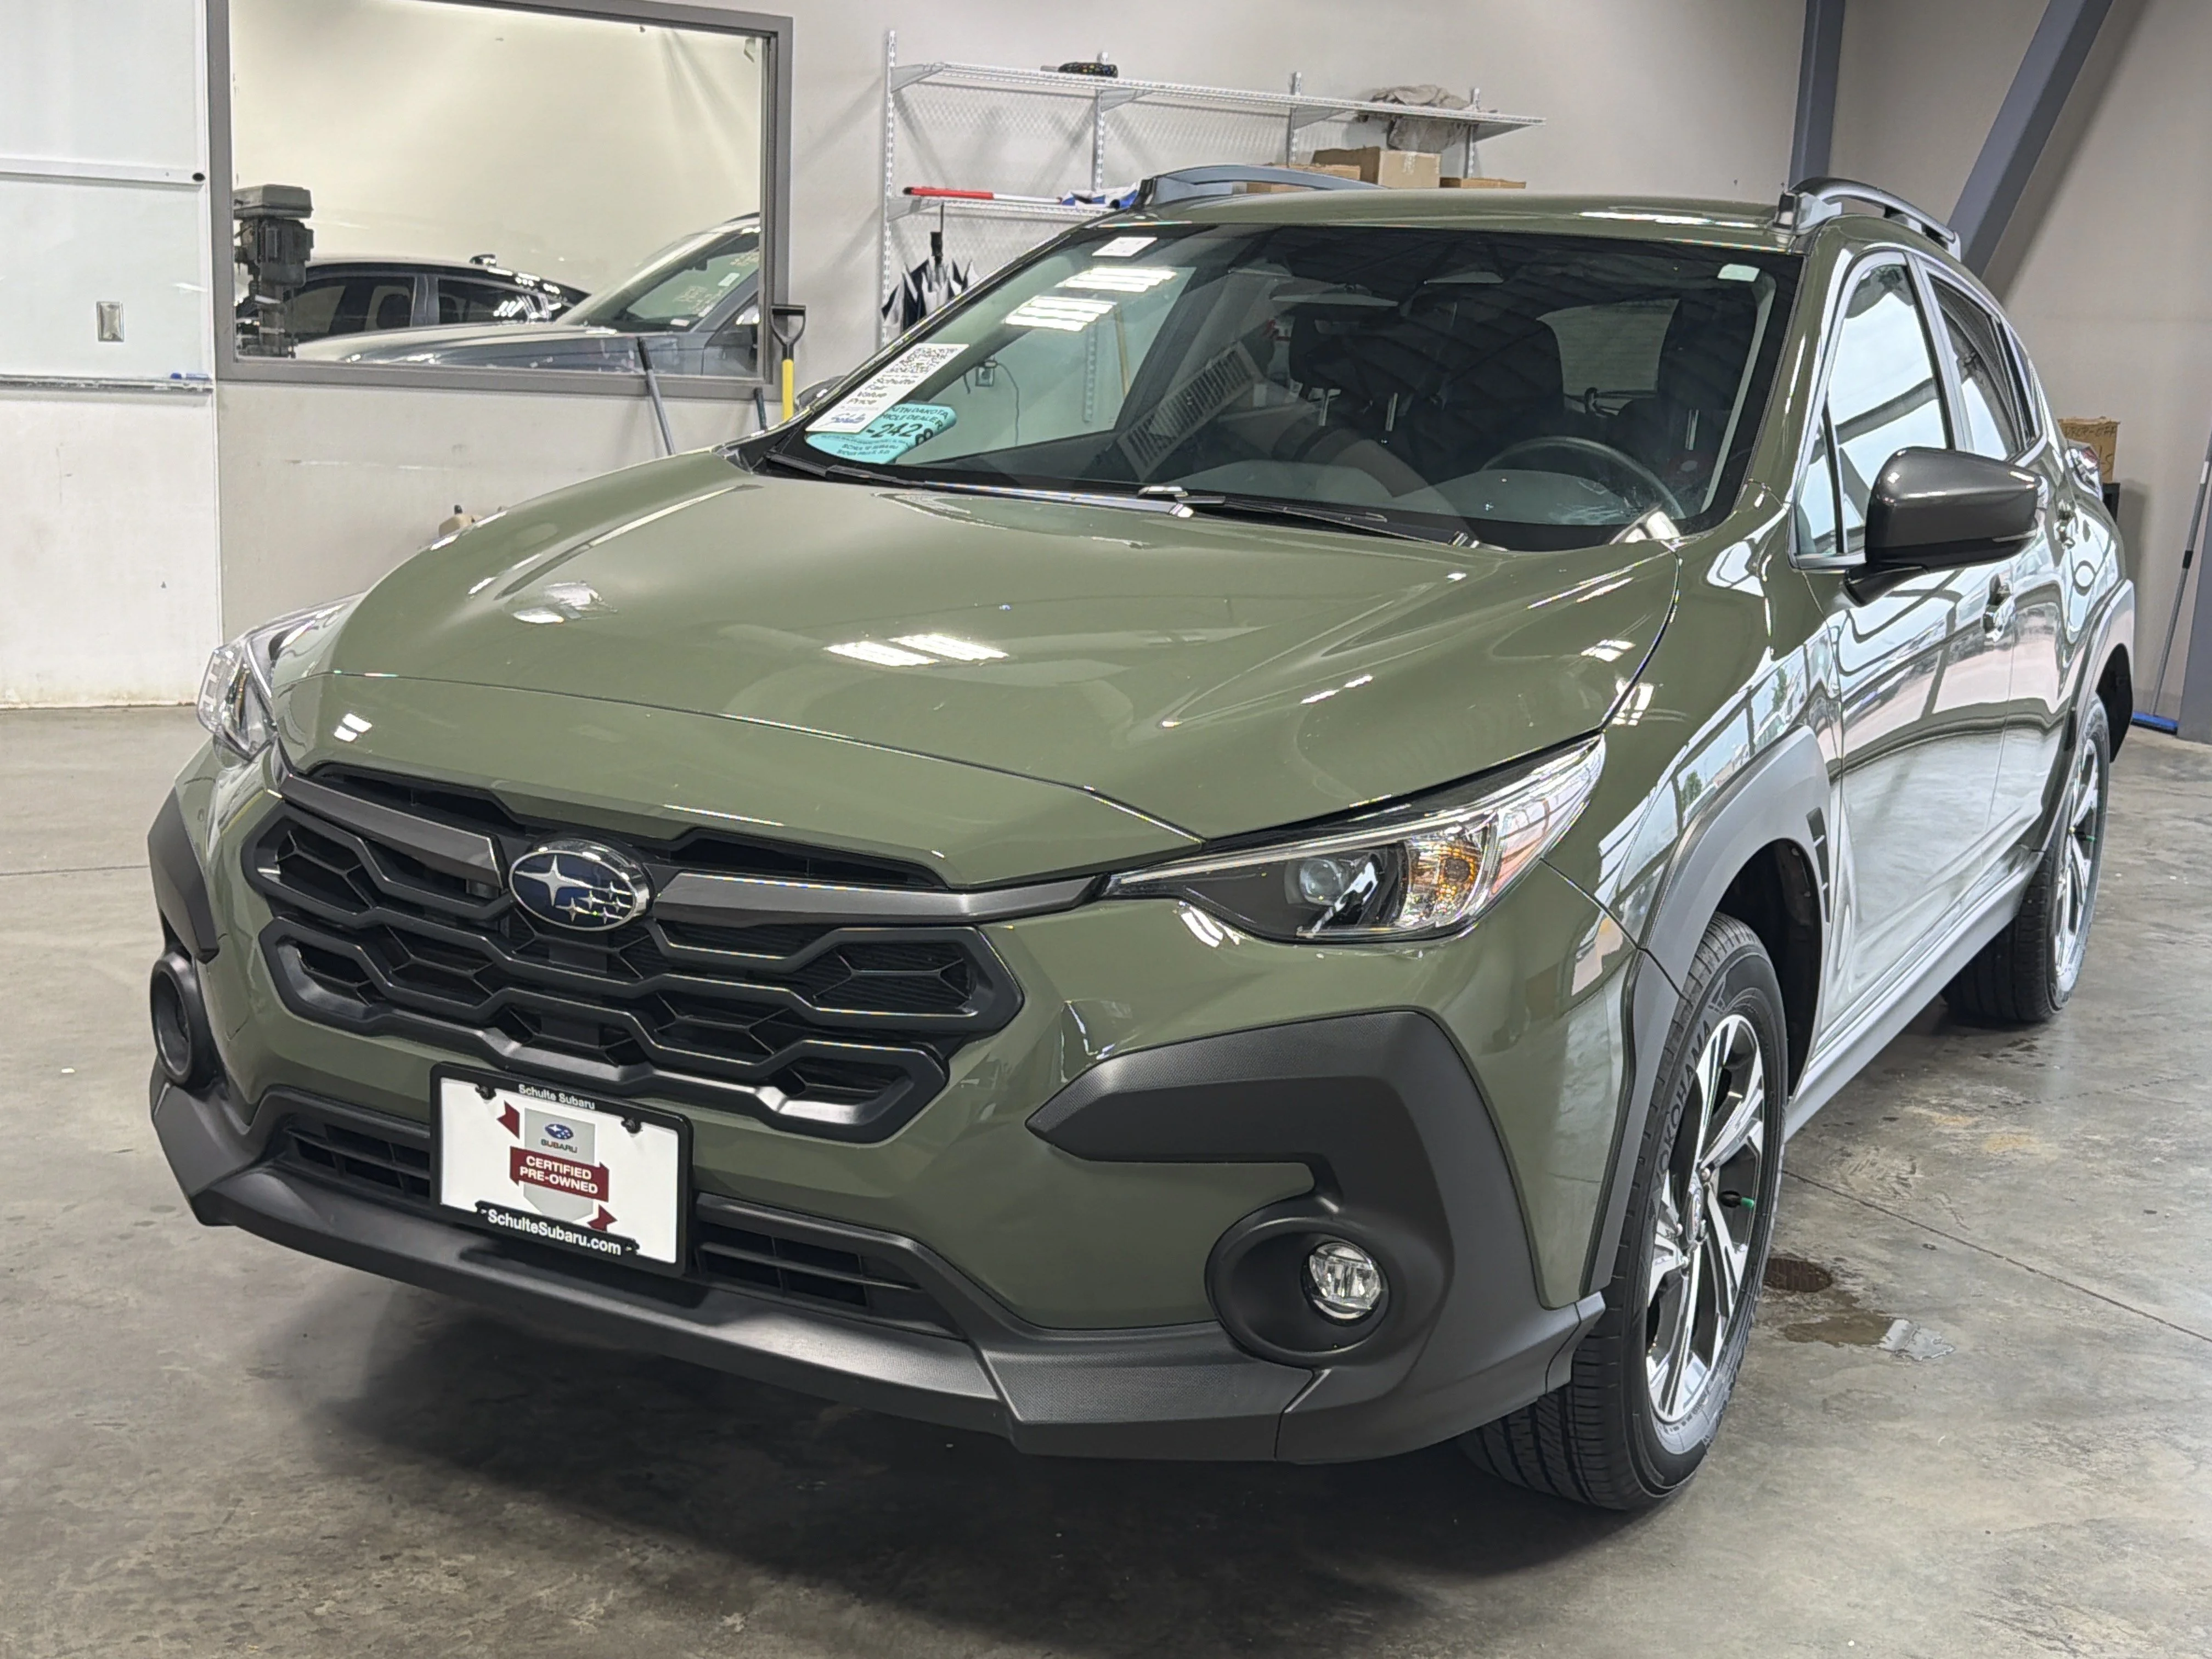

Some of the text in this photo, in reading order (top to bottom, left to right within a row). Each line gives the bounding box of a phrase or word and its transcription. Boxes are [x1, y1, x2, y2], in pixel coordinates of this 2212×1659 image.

[906, 414, 943, 431] DEALER
[911, 407, 949, 420] DAKOTA
[518, 1084, 596, 1110] Schulte Subaru
[540, 1138, 578, 1154] SUBARU
[519, 1166, 599, 1194] PRE-OWNED
[526, 1155, 592, 1180] CERTIFIED
[487, 1209, 622, 1256] SchulteSubaru.com
